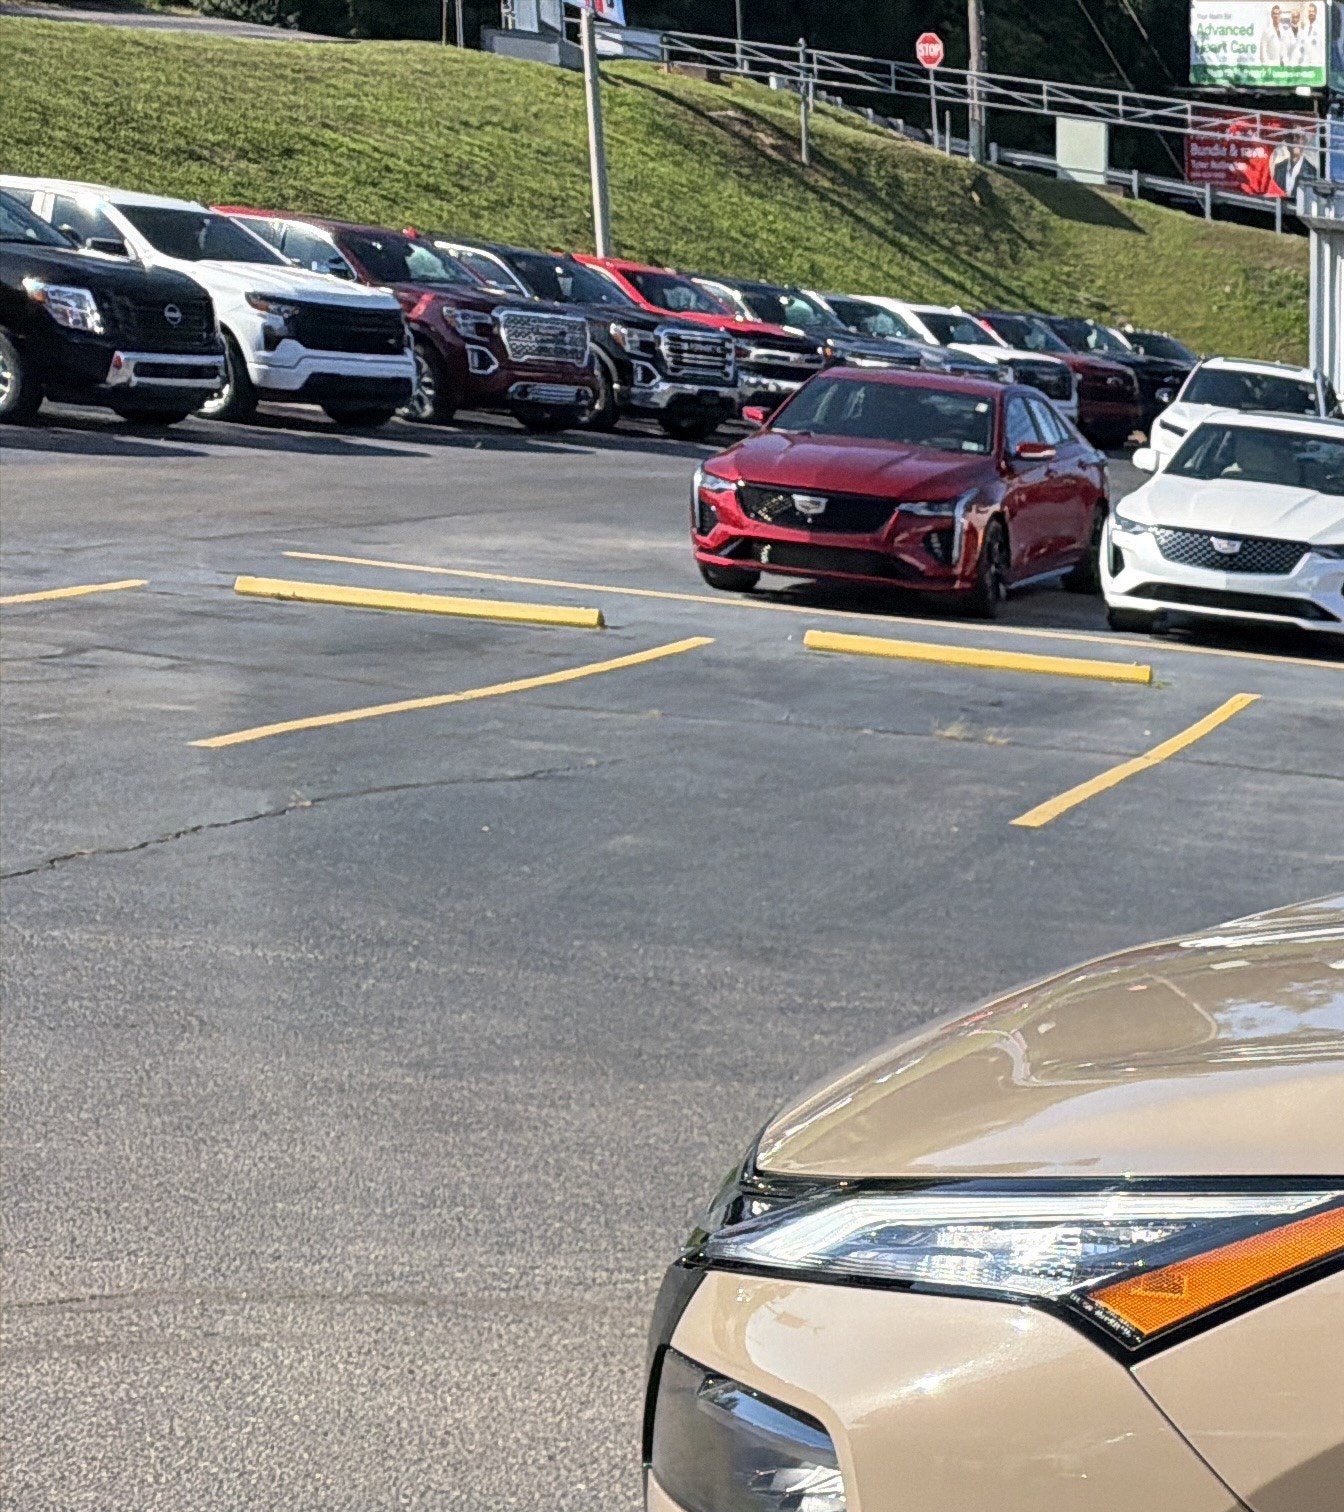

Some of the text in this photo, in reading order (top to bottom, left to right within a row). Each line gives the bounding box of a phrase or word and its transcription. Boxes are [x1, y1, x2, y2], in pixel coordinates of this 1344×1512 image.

[1196, 23, 1254, 36] Advanced
[919, 43, 941, 57] STOP
[1196, 40, 1257, 54] eart Care
